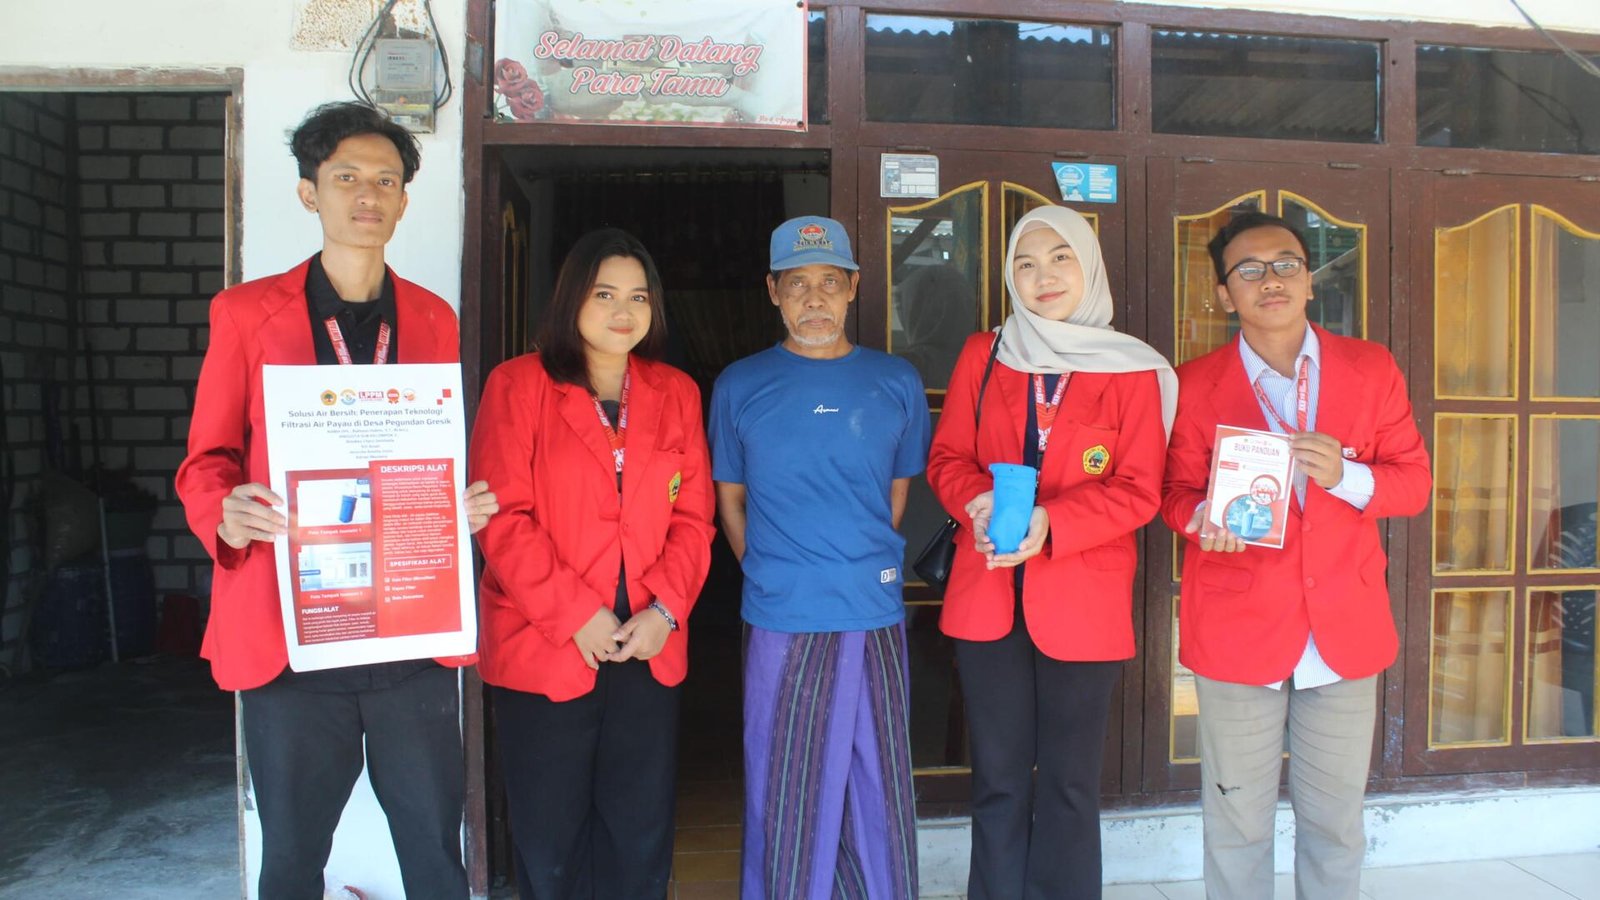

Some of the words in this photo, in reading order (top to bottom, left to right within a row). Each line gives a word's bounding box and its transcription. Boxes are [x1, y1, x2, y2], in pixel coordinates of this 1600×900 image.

[534, 31, 656, 62] Selamat
[657, 34, 765, 77] Datang
[569, 66, 645, 96] Para
[647, 66, 732, 98] Tamu
[288, 409, 314, 418] Solusi
[316, 409, 327, 417] Air
[360, 408, 403, 418] Penerapan
[405, 407, 443, 417] Teknologi
[281, 420, 311, 428] Filtrasi
[313, 420, 324, 428] Air
[327, 420, 352, 429] Payau
[353, 419, 362, 427] di
[363, 419, 383, 427] Desa
[1234, 443, 1251, 453] BUKU
[1251, 444, 1280, 457] PANDUAN
[380, 464, 425, 473] DESKRIPSI
[426, 463, 448, 471] ALAT
[390, 558, 428, 567] SPESIFIKASI
[429, 557, 446, 565] ALAT
